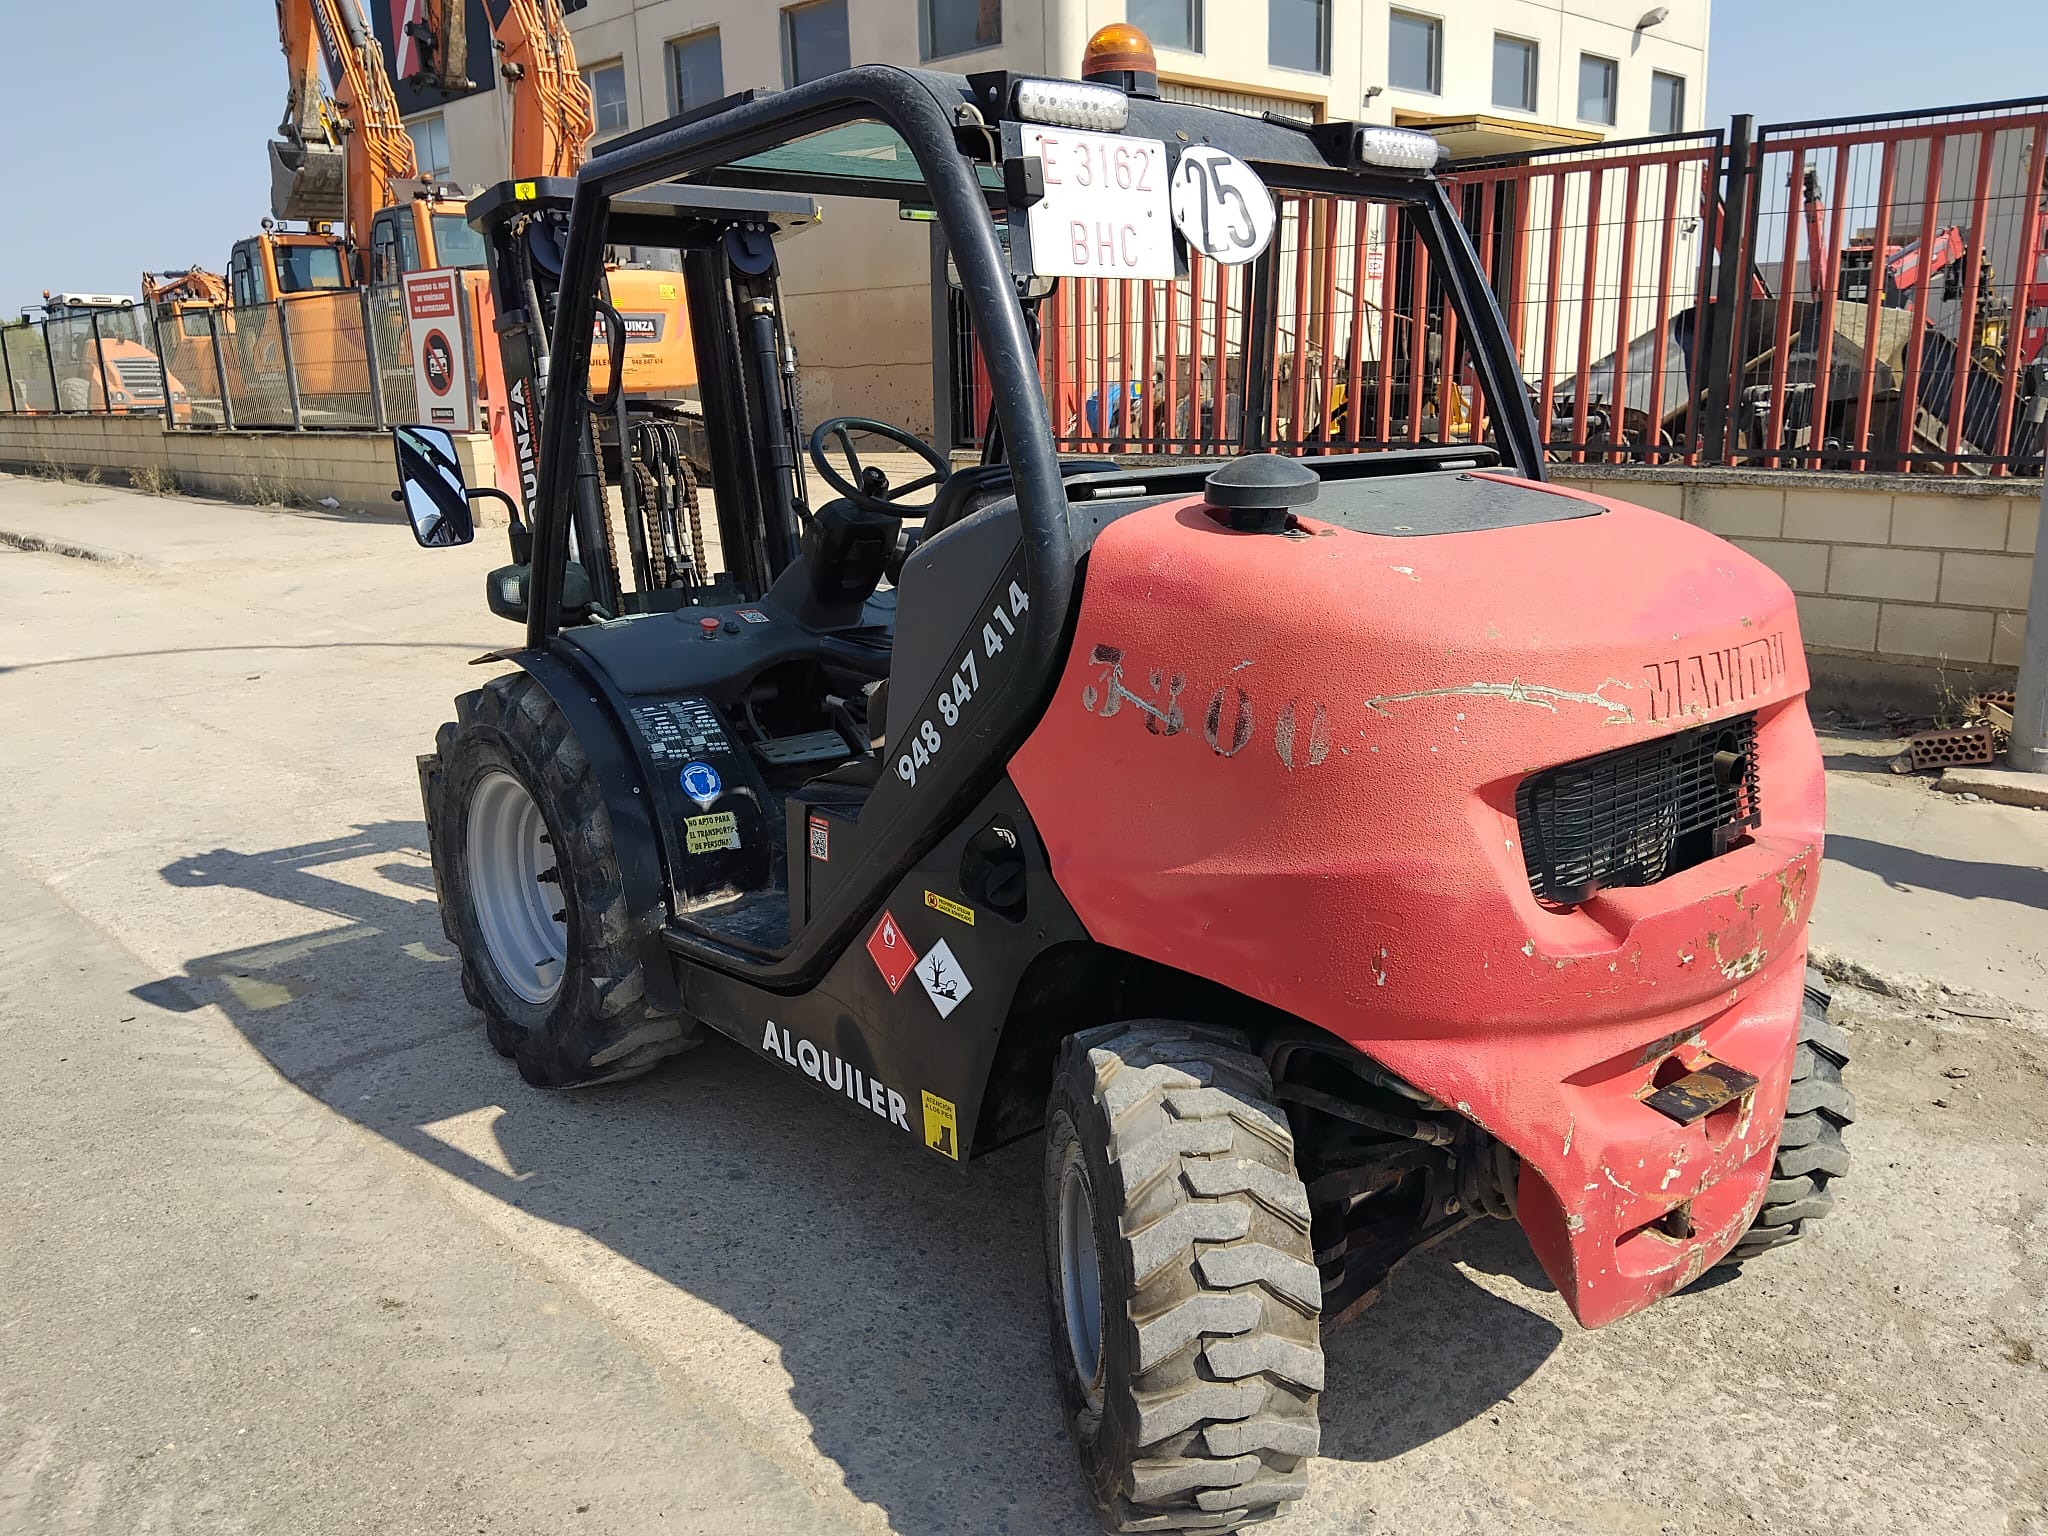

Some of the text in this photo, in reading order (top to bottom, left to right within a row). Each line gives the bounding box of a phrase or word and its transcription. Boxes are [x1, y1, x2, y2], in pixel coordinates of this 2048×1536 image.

[1041, 139, 1153, 192] E 3162
[1185, 156, 1257, 253] 25
[1070, 220, 1138, 267] BHC
[898, 580, 1030, 788] 948 847 414
[889, 974, 897, 987] 3
[761, 1019, 911, 1132] ALQUILER
